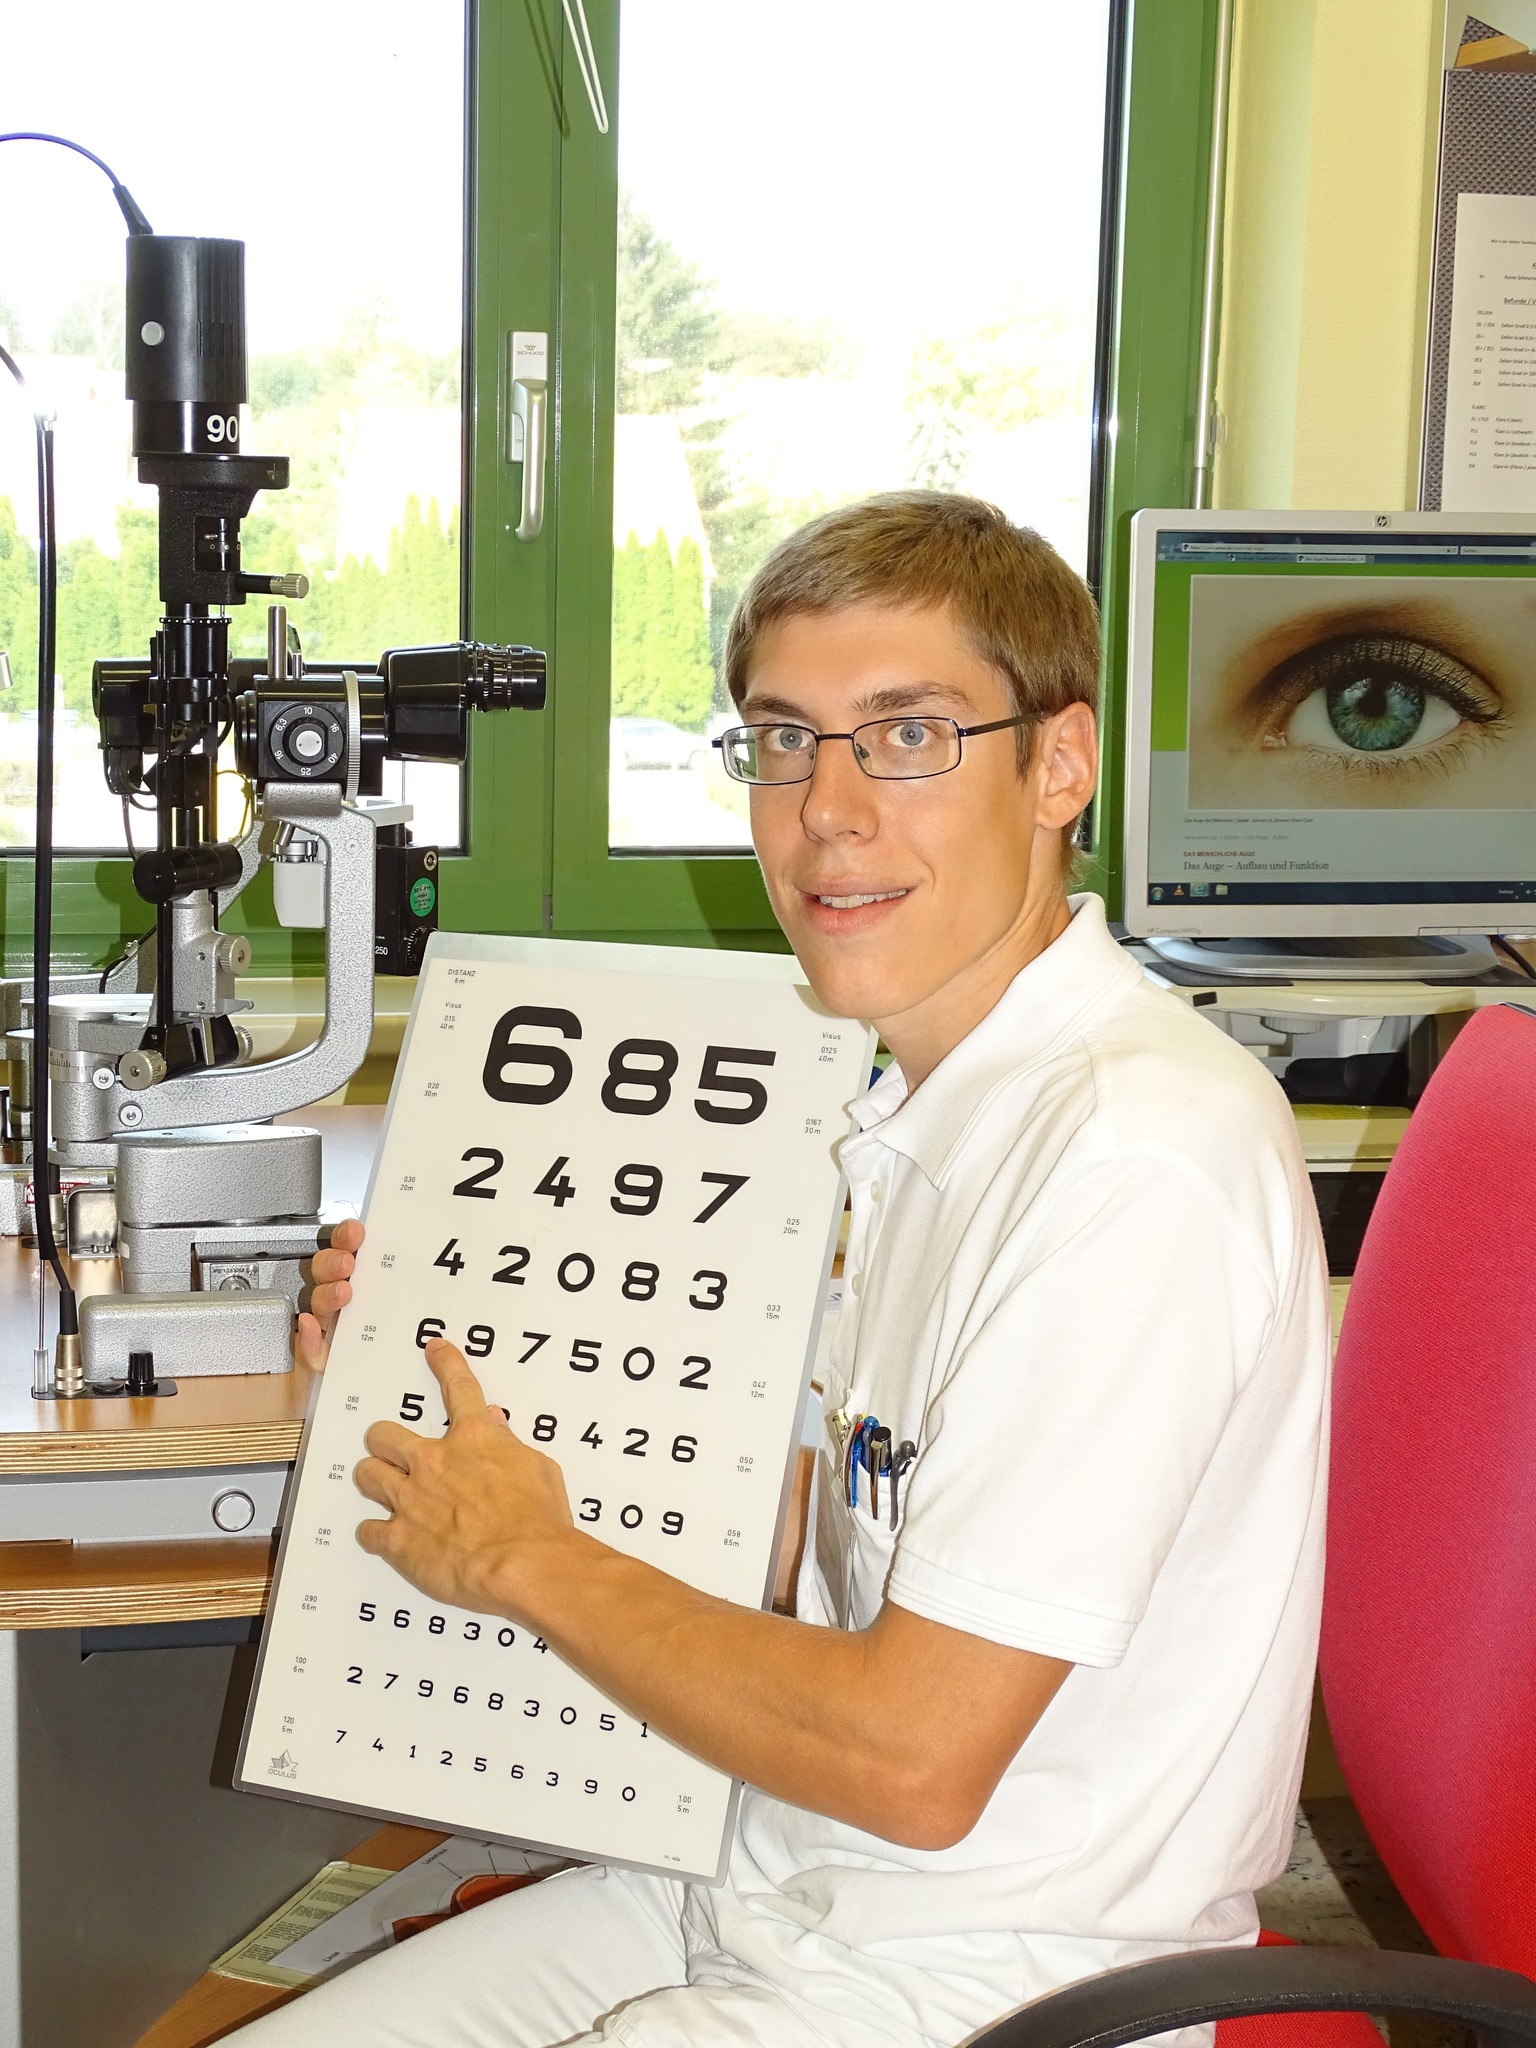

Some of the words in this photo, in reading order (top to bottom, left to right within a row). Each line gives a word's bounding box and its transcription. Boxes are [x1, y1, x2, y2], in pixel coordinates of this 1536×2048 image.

[303, 706, 313, 715] 10
[330, 723, 340, 733] 16
[274, 750, 284, 760] 16
[300, 767, 312, 776] 25
[328, 752, 338, 764] 40
[1184, 861, 1200, 870] Das
[1202, 861, 1225, 872] Auge
[1235, 861, 1267, 870] Aufbau
[1270, 861, 1287, 870] und
[1289, 861, 1329, 870] Funktion
[821, 1032, 841, 1040] Visus
[482, 1005, 583, 1106] 6
[600, 1038, 679, 1116] 8
[694, 1045, 777, 1125] 5
[452, 1146, 504, 1200] 2
[532, 1156, 576, 1208] 4
[610, 1163, 663, 1217] 9
[692, 1171, 751, 1224] 7
[432, 1238, 465, 1277] 4
[491, 1245, 531, 1286] 2
[621, 1261, 660, 1302] 8
[688, 1269, 728, 1311] 3
[415, 1317, 446, 1350] 6
[464, 1324, 496, 1358] 9
[517, 1331, 552, 1364] 7
[568, 1338, 603, 1373] 5
[679, 1355, 712, 1391] 2
[399, 1392, 425, 1422] 5
[532, 1413, 558, 1443] 8
[579, 1421, 603, 1450] 4
[622, 1427, 650, 1457] 2
[671, 1434, 698, 1463] 6
[579, 1497, 602, 1522] 3
[661, 1511, 684, 1536] 9
[358, 1602, 377, 1622] 5
[393, 1609, 411, 1629] 6
[428, 1615, 446, 1635] 8
[463, 1621, 481, 1641] 3
[532, 1636, 549, 1654] 4
[346, 1665, 363, 1685] 2
[383, 1672, 400, 1691] 7
[417, 1679, 434, 1698] 9
[453, 1685, 470, 1704] 6
[487, 1692, 504, 1711] 8
[523, 1699, 540, 1718] 3
[599, 1713, 616, 1732] 5
[640, 1721, 649, 1739] 1
[267, 1768, 297, 1779] OCULUS
[335, 1729, 348, 1744] 7
[371, 1737, 385, 1753] 4
[408, 1744, 417, 1759] 1
[439, 1750, 453, 1766] 2
[473, 1756, 487, 1773] 5
[510, 1764, 525, 1780] 6
[545, 1771, 559, 1787] 3
[584, 1779, 598, 1795] 9
